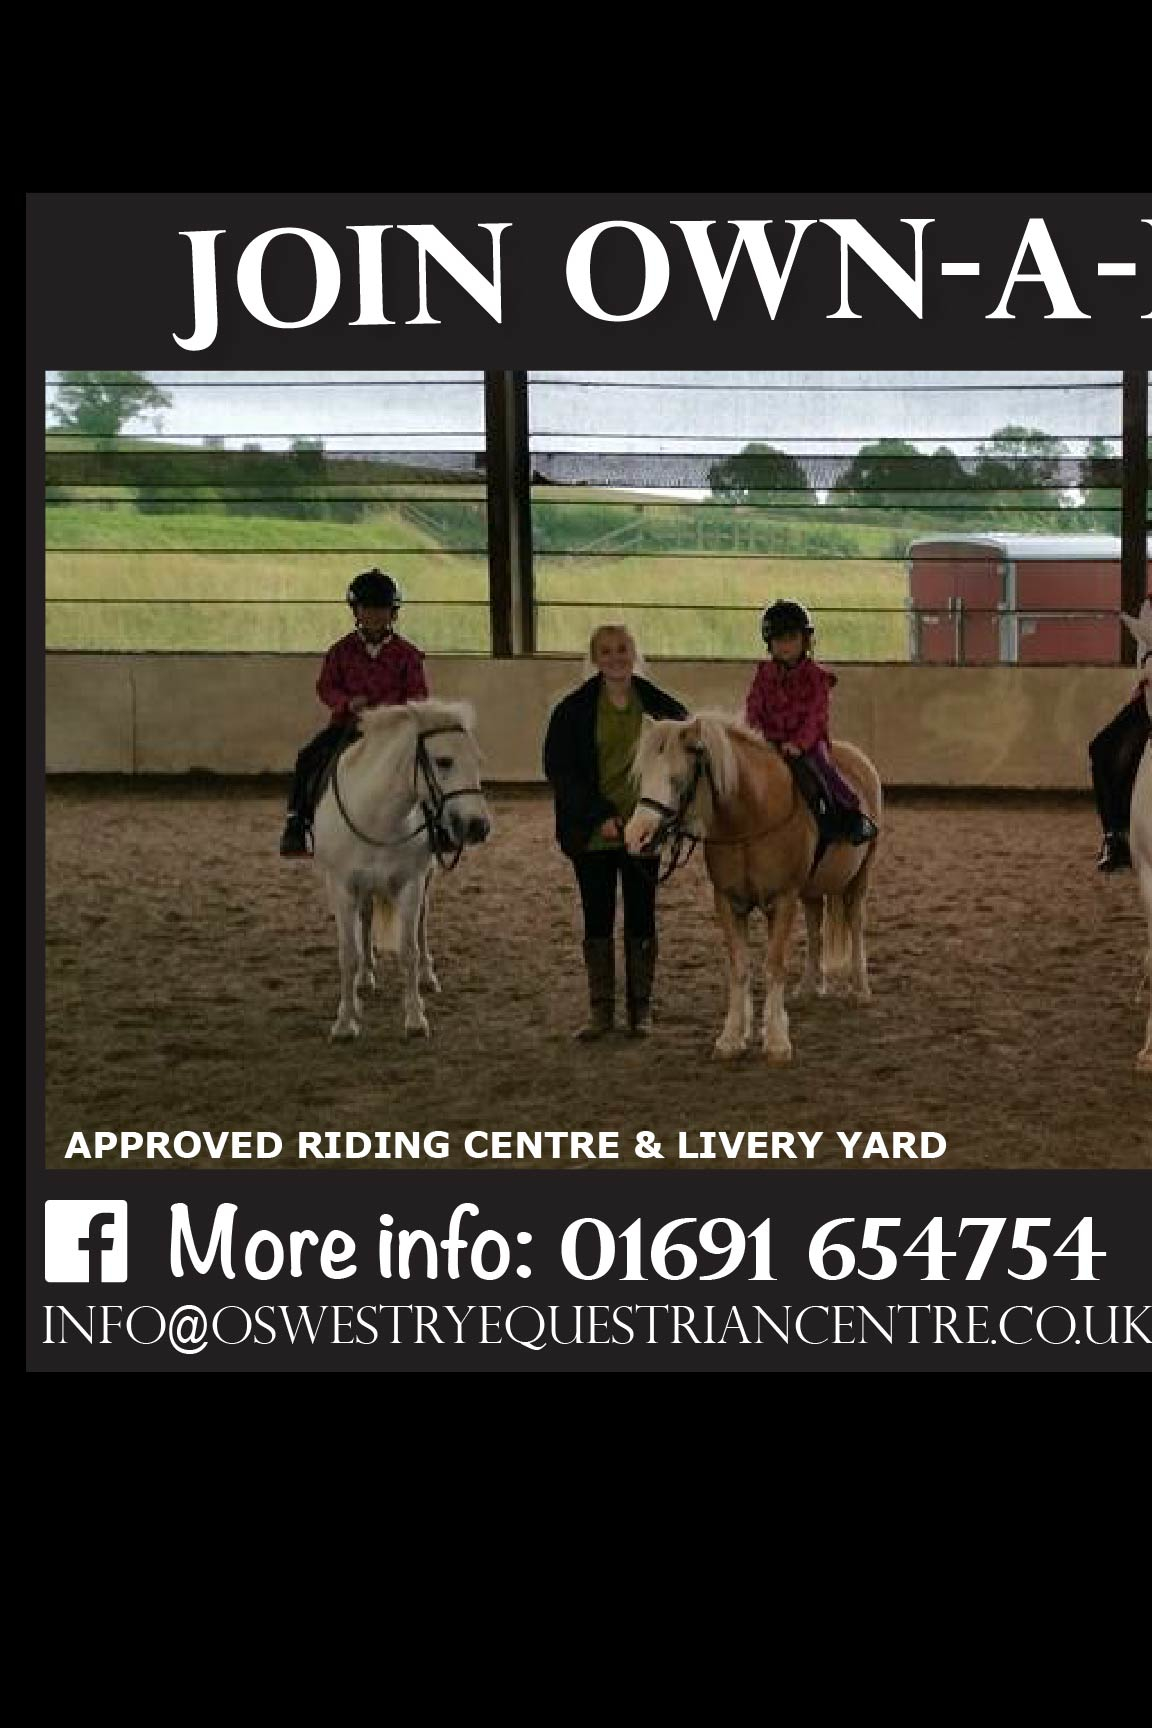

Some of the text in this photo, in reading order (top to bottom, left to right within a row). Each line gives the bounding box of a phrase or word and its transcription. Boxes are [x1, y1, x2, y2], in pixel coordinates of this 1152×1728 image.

[173, 223, 512, 351] JOIN
[65, 1131, 947, 1159] APPROVED RIDING CENTRE & LIVERY YARD
[171, 1203, 1107, 1281] More info: 01691 654754
